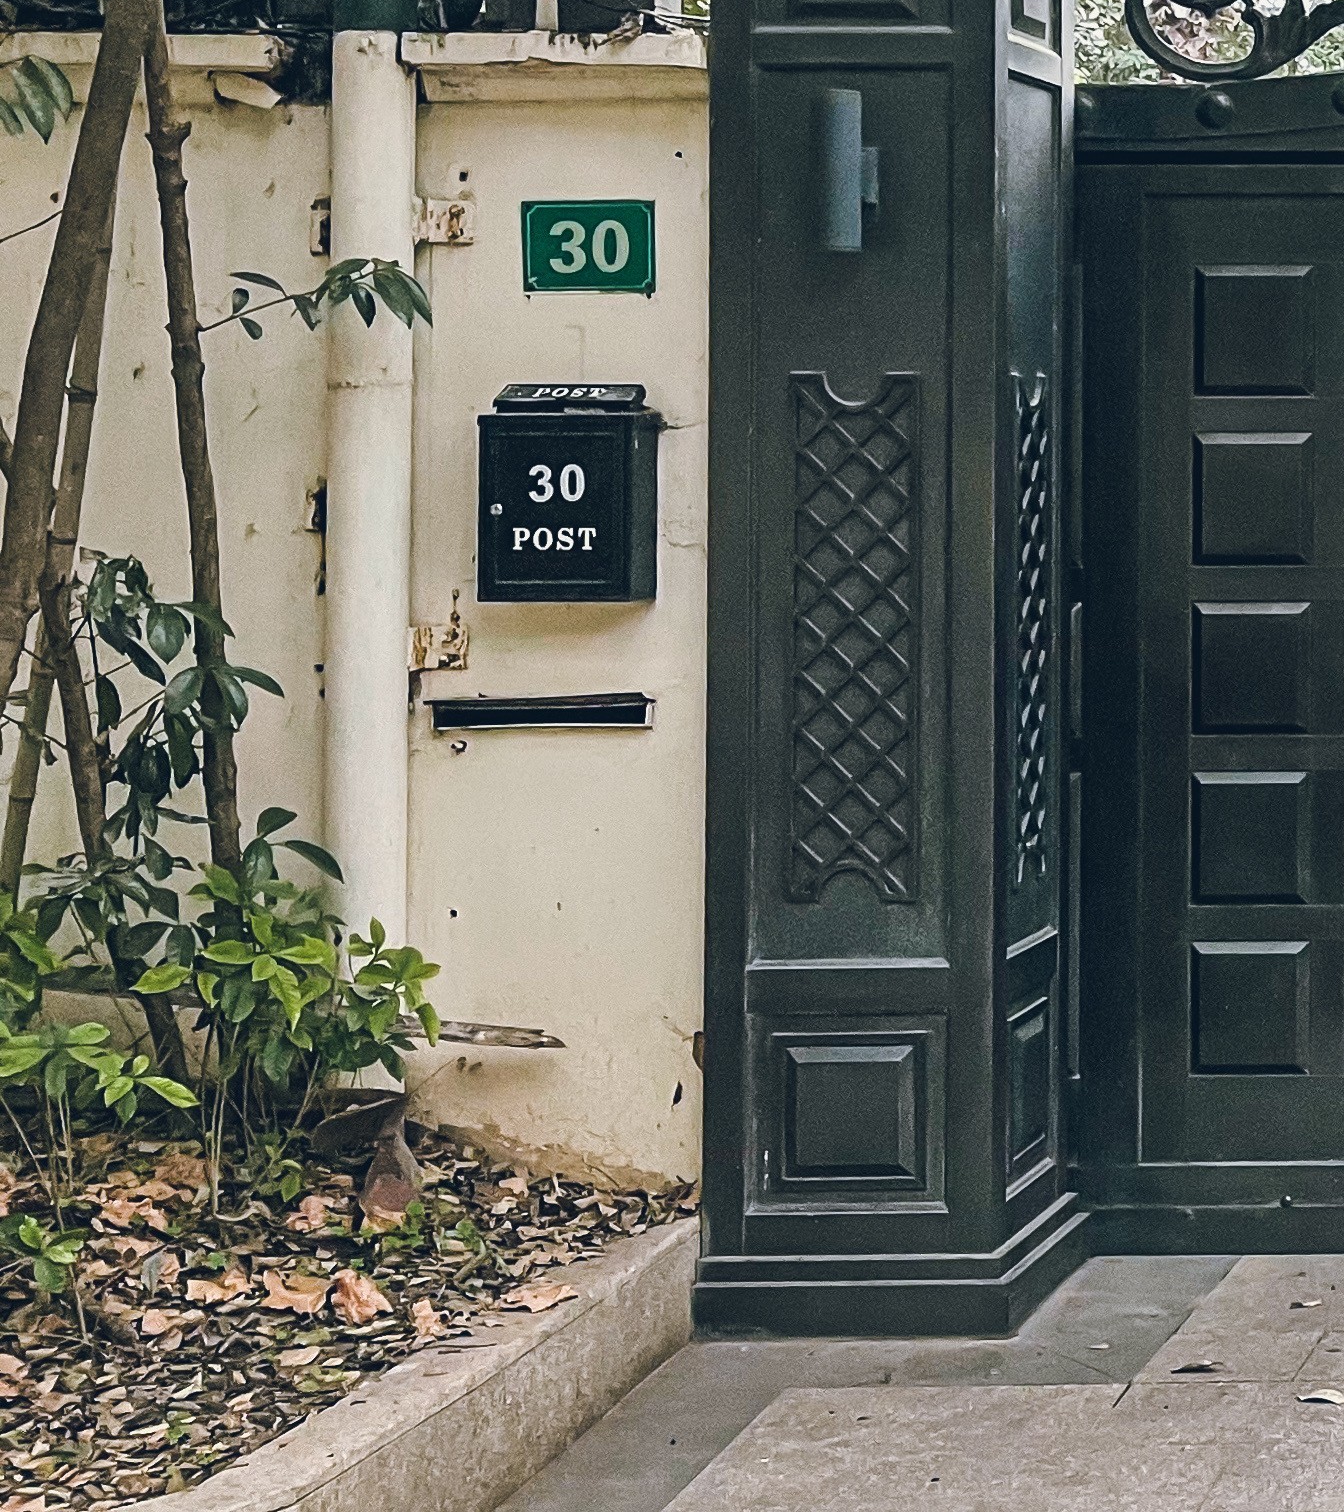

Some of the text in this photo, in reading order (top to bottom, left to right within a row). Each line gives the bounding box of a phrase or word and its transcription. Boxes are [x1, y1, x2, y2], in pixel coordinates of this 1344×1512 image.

[547, 219, 631, 275] 30
[531, 387, 607, 398] POST
[527, 463, 587, 504] 30
[512, 527, 598, 551] POST
